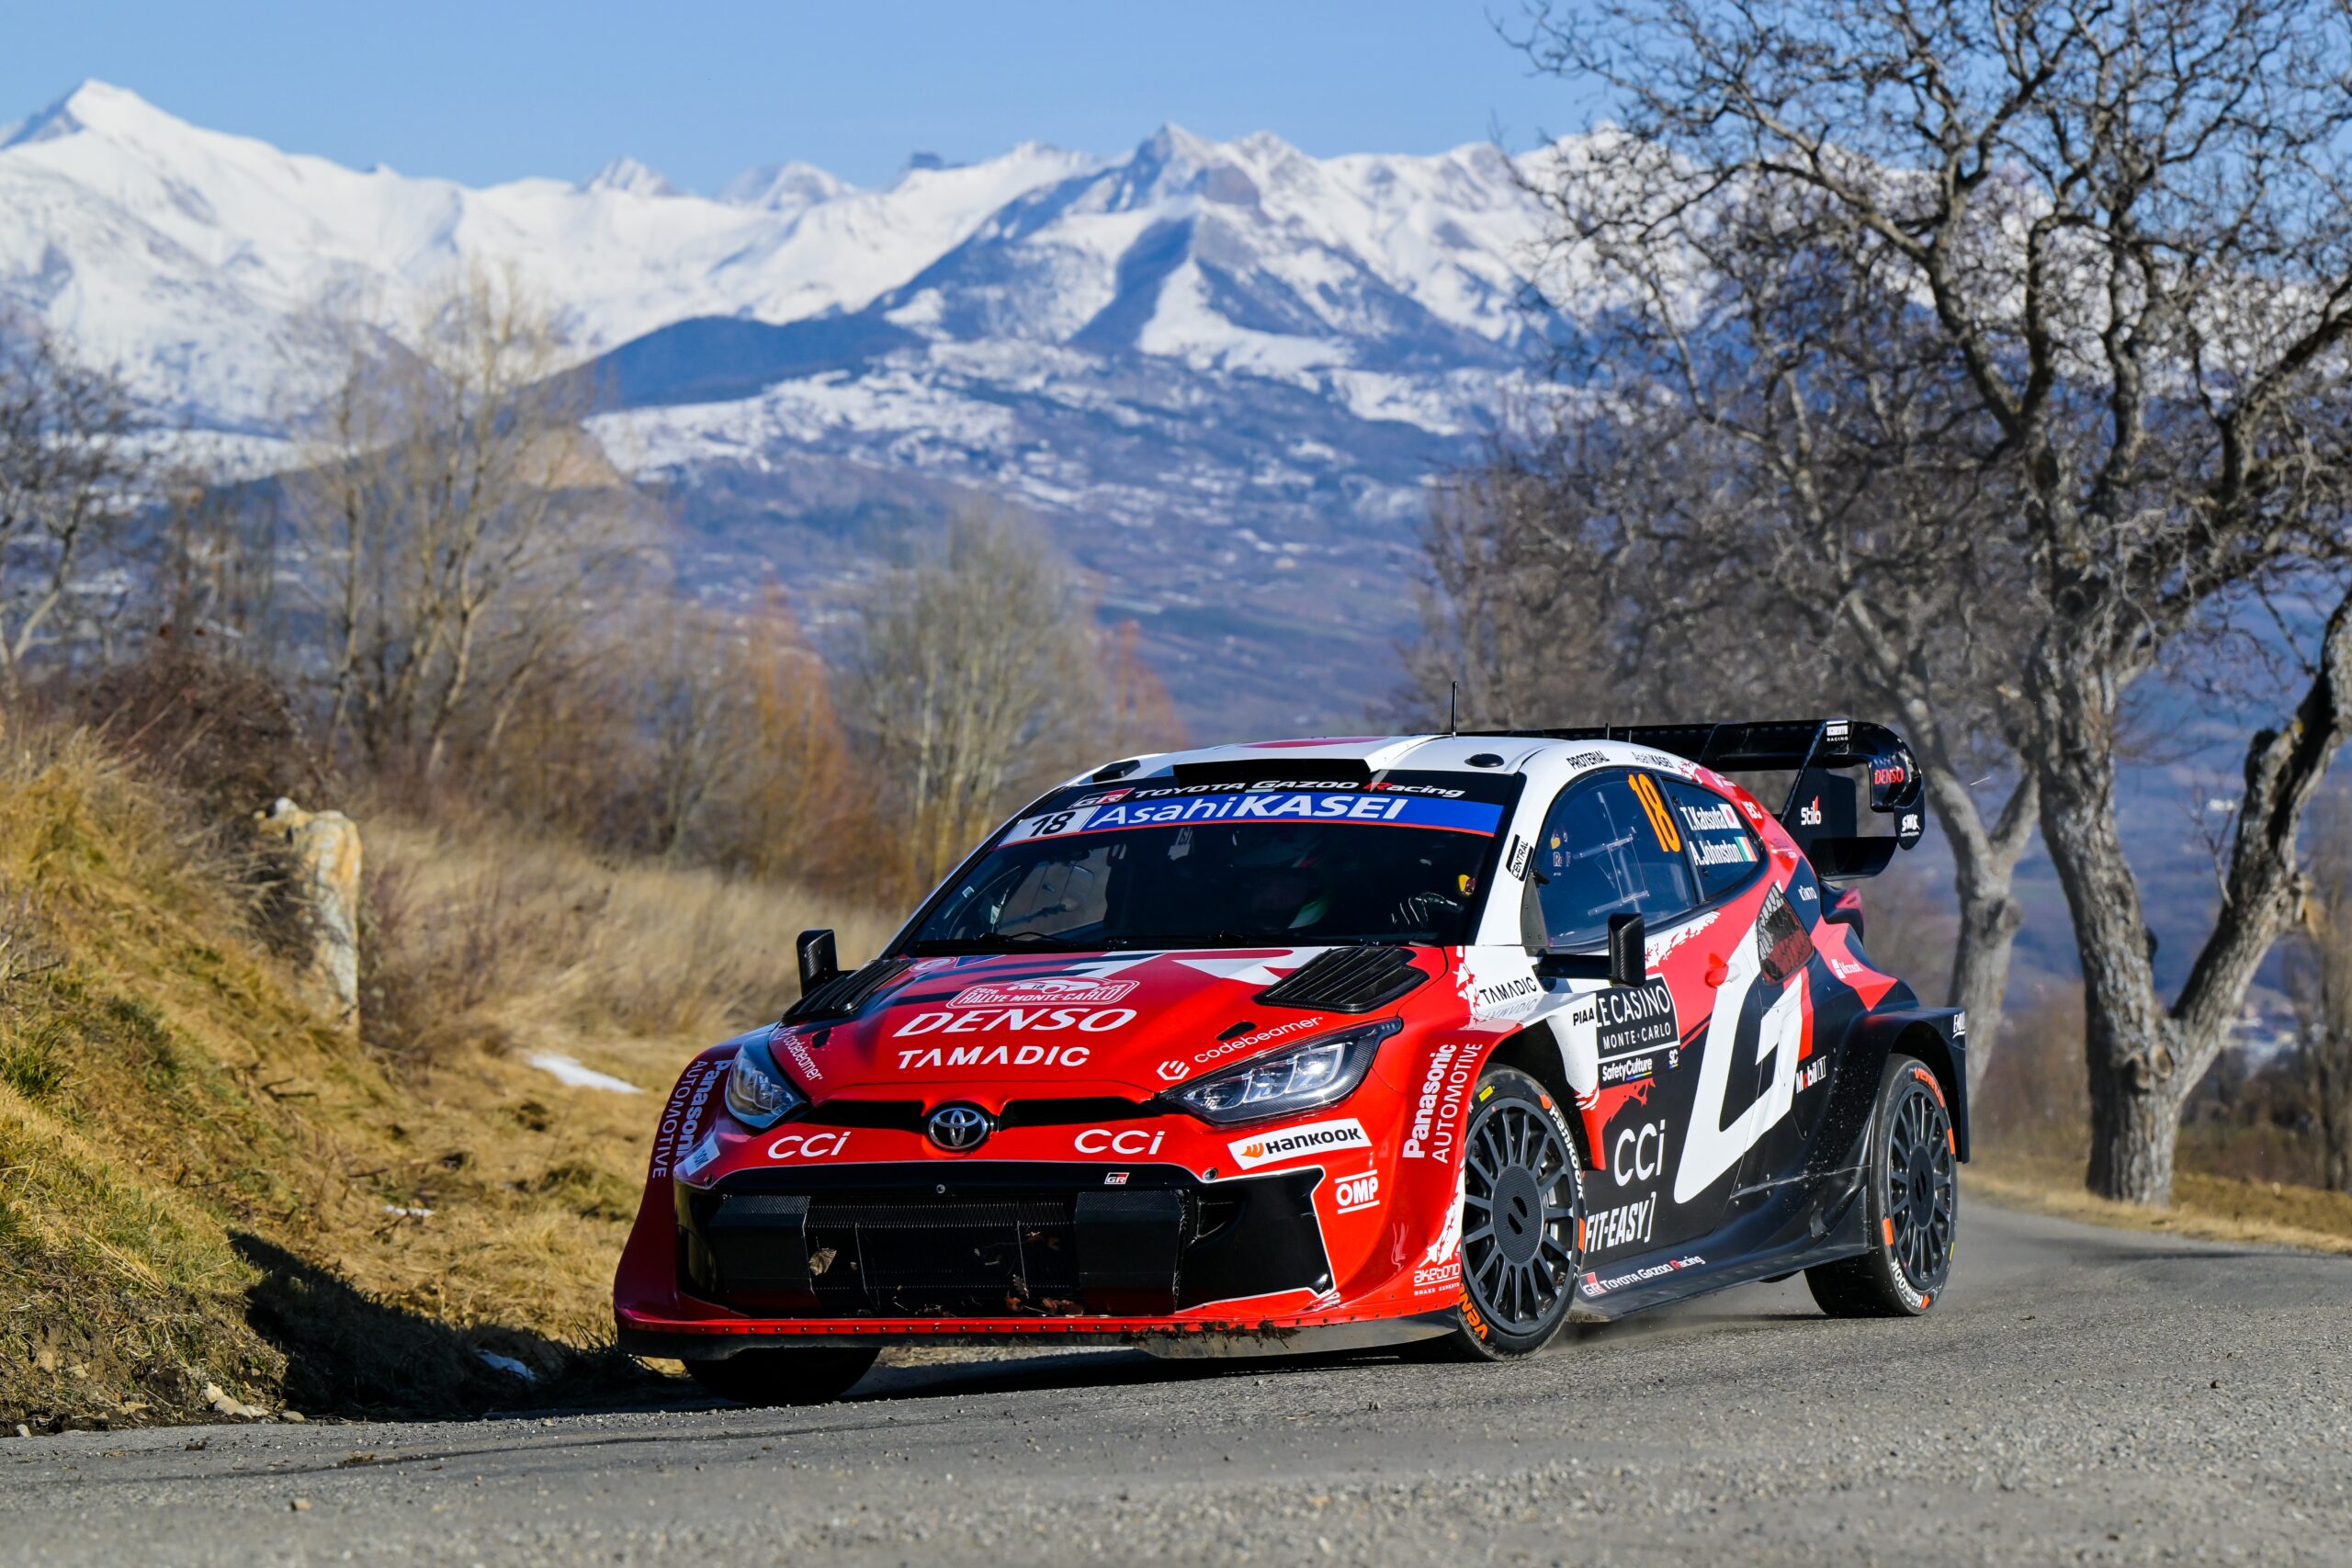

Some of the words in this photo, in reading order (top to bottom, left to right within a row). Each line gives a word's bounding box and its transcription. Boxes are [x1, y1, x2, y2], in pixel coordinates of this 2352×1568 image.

[1566, 750, 1610, 770] PROTERIAL
[1874, 766, 1905, 785] DENSO
[1074, 792, 1126, 808] GR
[1135, 782, 1246, 799] TOYOTA
[1251, 780, 1360, 790] GAZOO
[1363, 781, 1466, 798] Racing
[1029, 811, 1077, 838] 18
[1628, 773, 1681, 852] 18
[1801, 796, 1822, 826] Stilo
[1511, 840, 1529, 879] CENTRAL
[958, 989, 1009, 1005] RALLYE
[1012, 988, 1122, 1002] MONTE-CARLO
[1479, 976, 1537, 1005] TAMADIC
[1610, 985, 1671, 1024] CASINO
[892, 1008, 1137, 1038] DENSO
[1573, 1007, 1595, 1026] PIAA
[898, 1045, 1091, 1069] TAMADIC
[1602, 1057, 1653, 1081] SafetyCulture
[1795, 1061, 1818, 1094] Mobil
[674, 1059, 734, 1165] Panasoni
[1402, 1043, 1457, 1158] Panasonic
[1432, 1043, 1483, 1164] AUTOMOTIVE
[652, 1060, 708, 1179] AUTOMOTIVE
[1106, 1174, 1128, 1184] GR
[1336, 1176, 1379, 1207] OMP
[1414, 1288, 1435, 1296] BRAKE
[1439, 1282, 1461, 1292] EXPERTS
[1582, 1282, 1606, 1296] GR
[1600, 1273, 1640, 1290] TOYOTA
[1638, 1263, 1674, 1279] GAZOO
[1669, 1256, 1706, 1270] Racing
